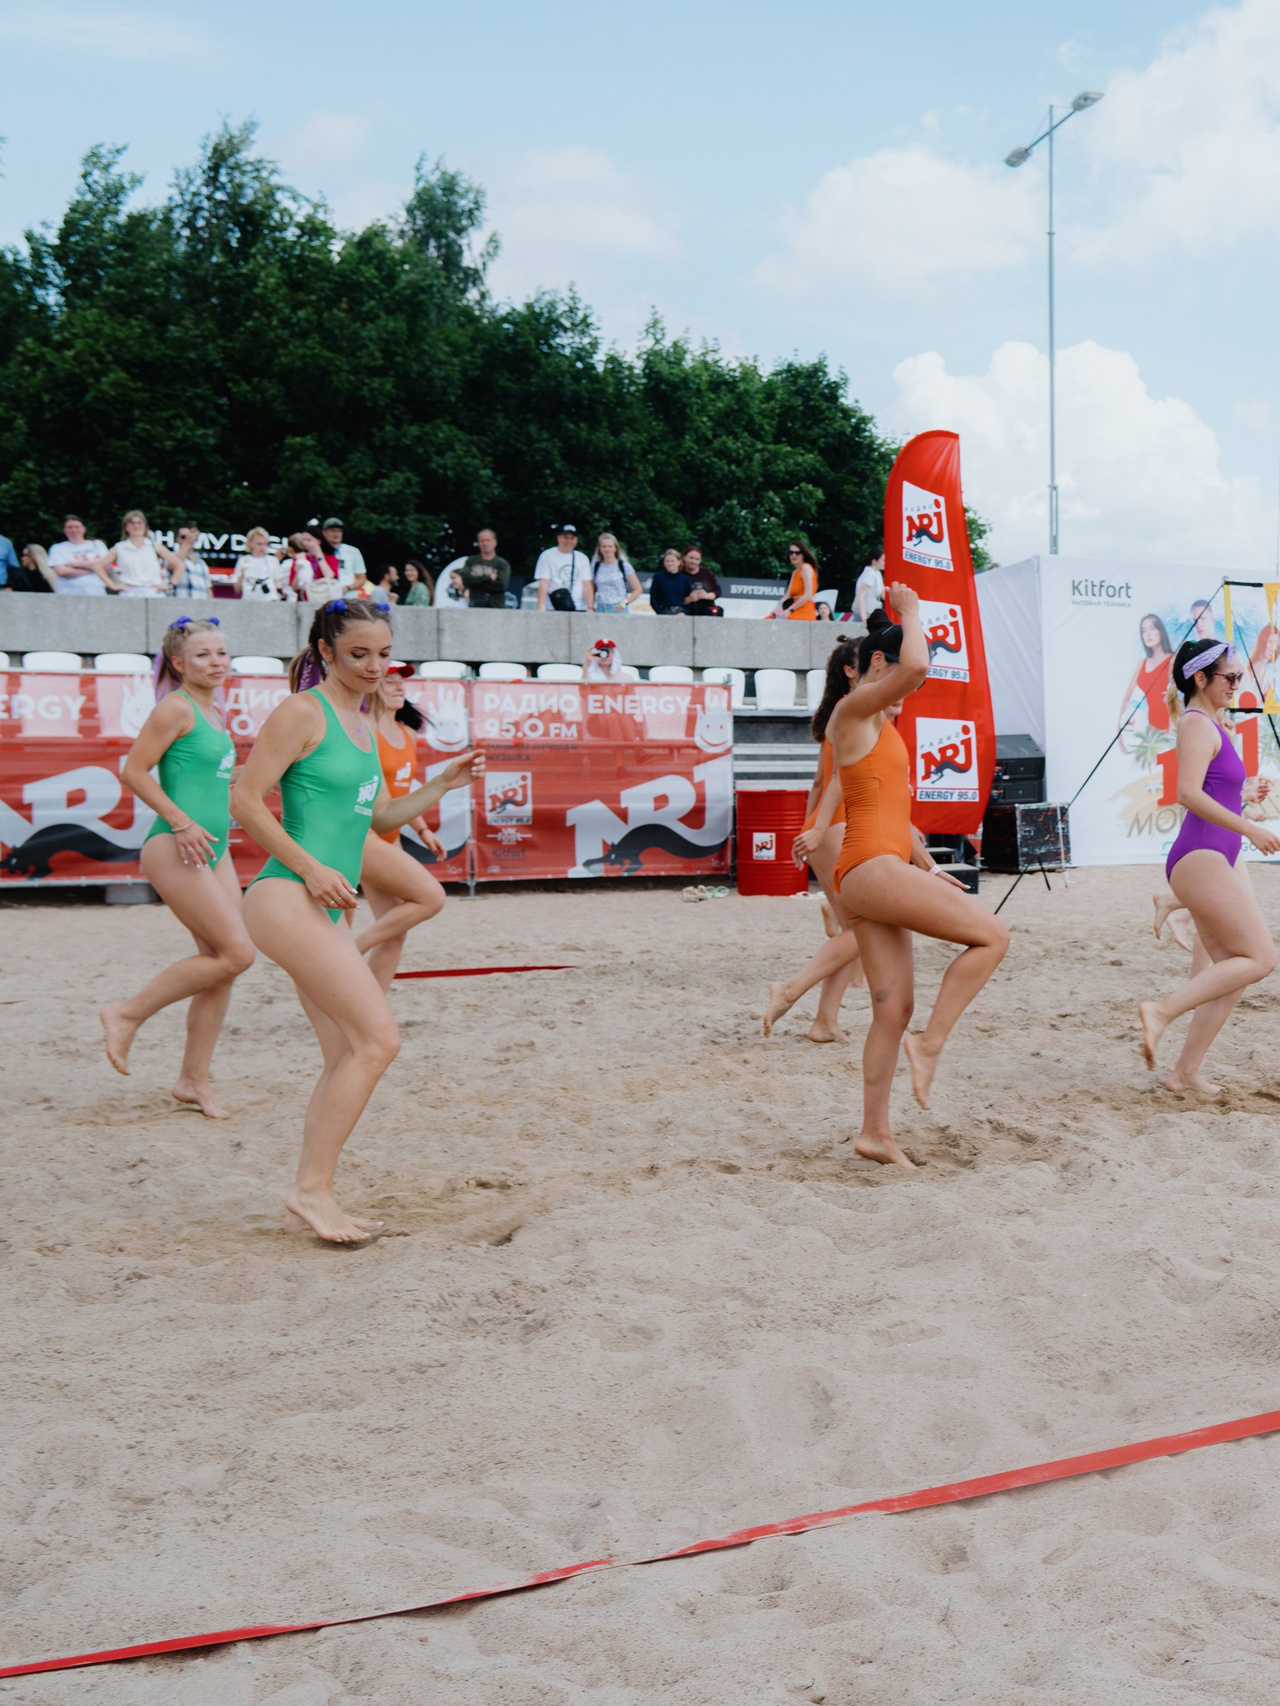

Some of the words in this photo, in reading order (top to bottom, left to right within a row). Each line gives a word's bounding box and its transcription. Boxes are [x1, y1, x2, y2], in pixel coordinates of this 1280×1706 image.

[904, 551, 933, 566] ENERGY
[934, 559, 952, 571] 95.0
[730, 584, 786, 596] БУРГЕРНАЯ
[1071, 578, 1132, 599] Kitfort
[951, 668, 968, 681] 95.0
[484, 692, 580, 717] РАДИО
[587, 693, 692, 715] ENERGY
[484, 717, 545, 738] 95.0
[550, 722, 578, 738] FM
[918, 790, 955, 800] ENERGY
[957, 790, 977, 800] 95.0
